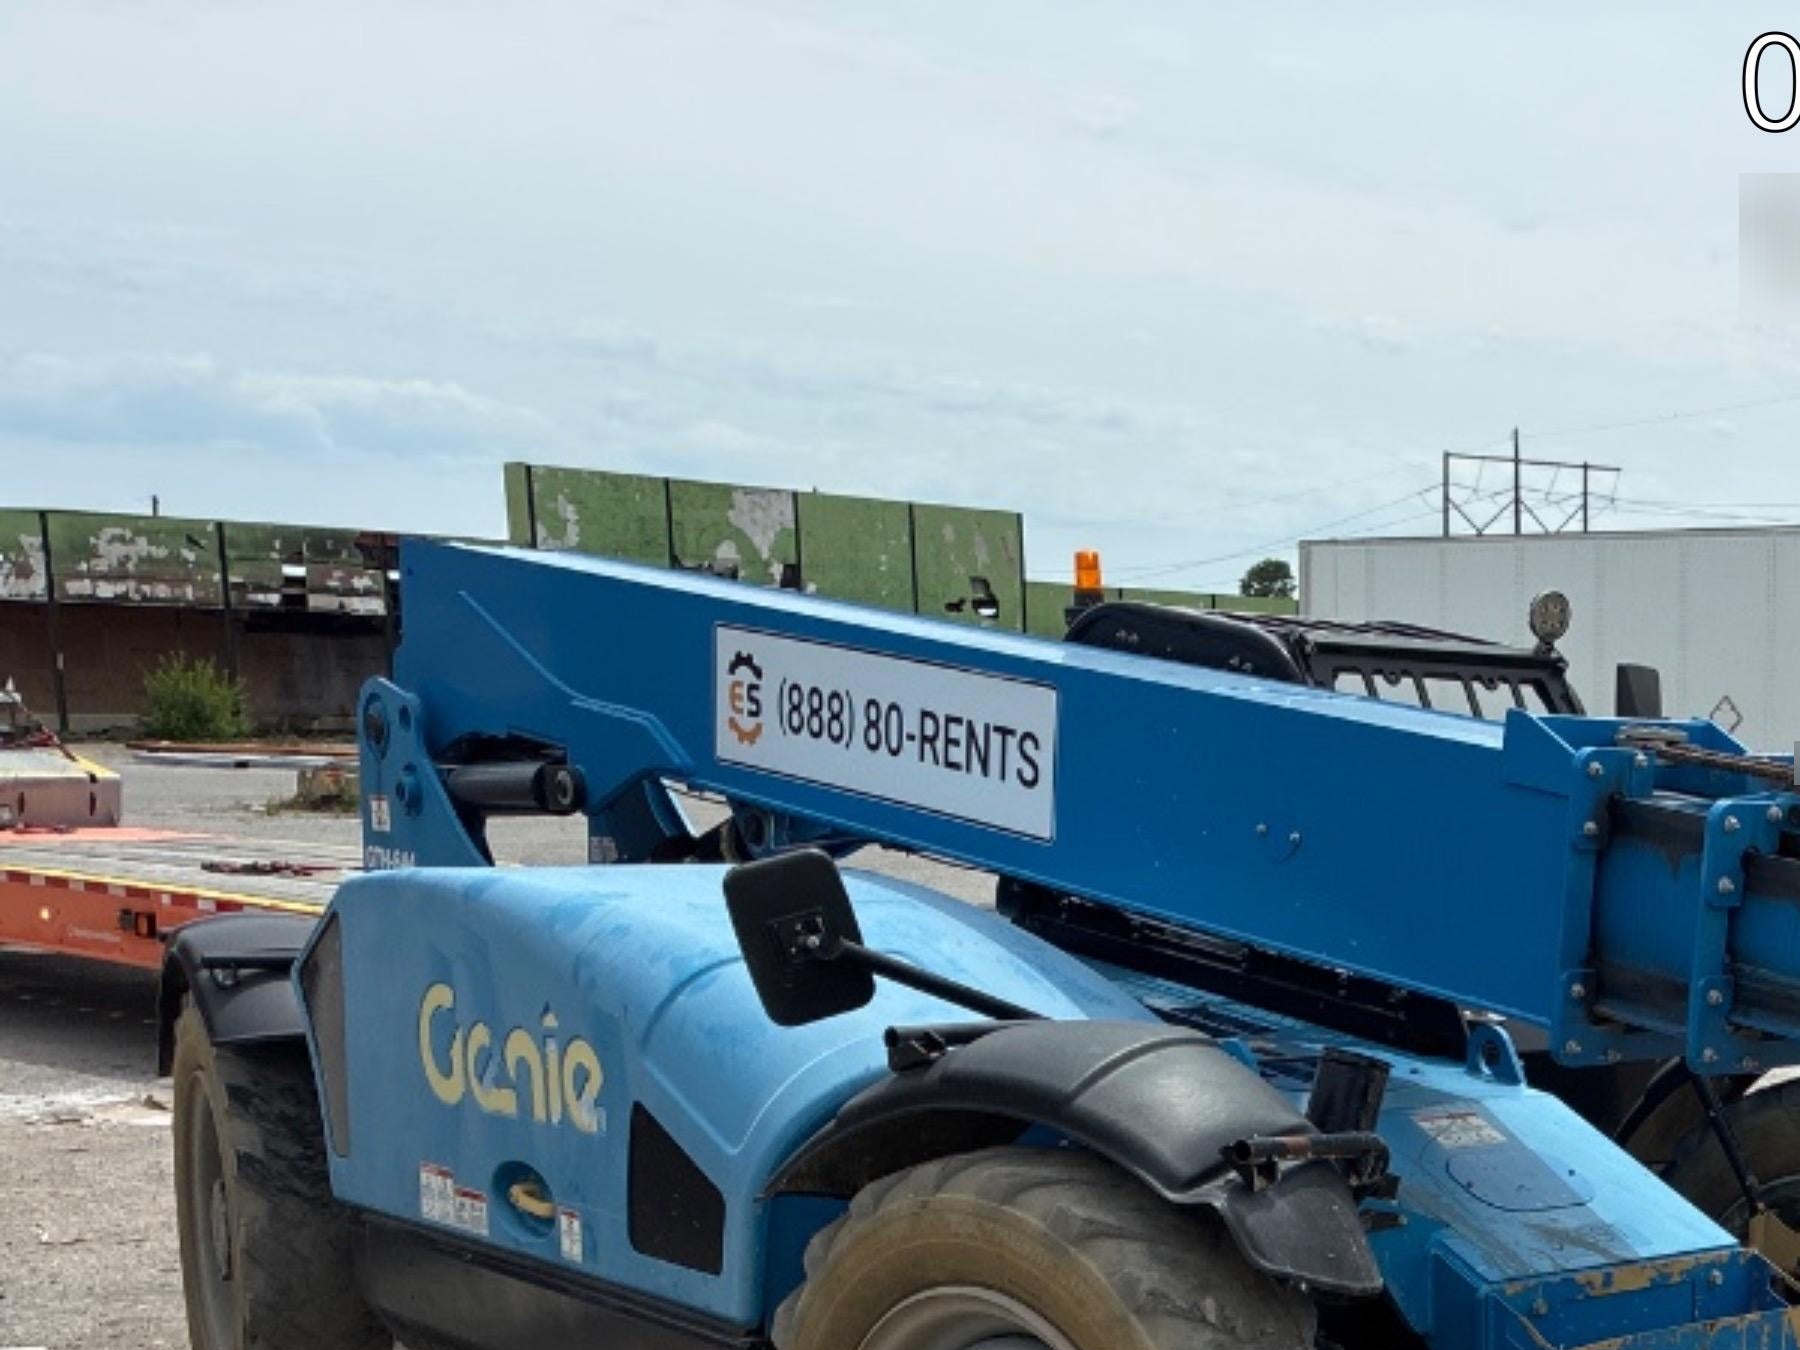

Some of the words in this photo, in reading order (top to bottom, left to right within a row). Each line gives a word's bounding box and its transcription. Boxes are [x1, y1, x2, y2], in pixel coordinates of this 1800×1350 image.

[729, 680, 762, 717] ES
[778, 677, 855, 750] (888)
[863, 698, 1040, 790] 80-RENTS
[420, 981, 605, 1133] Genie
